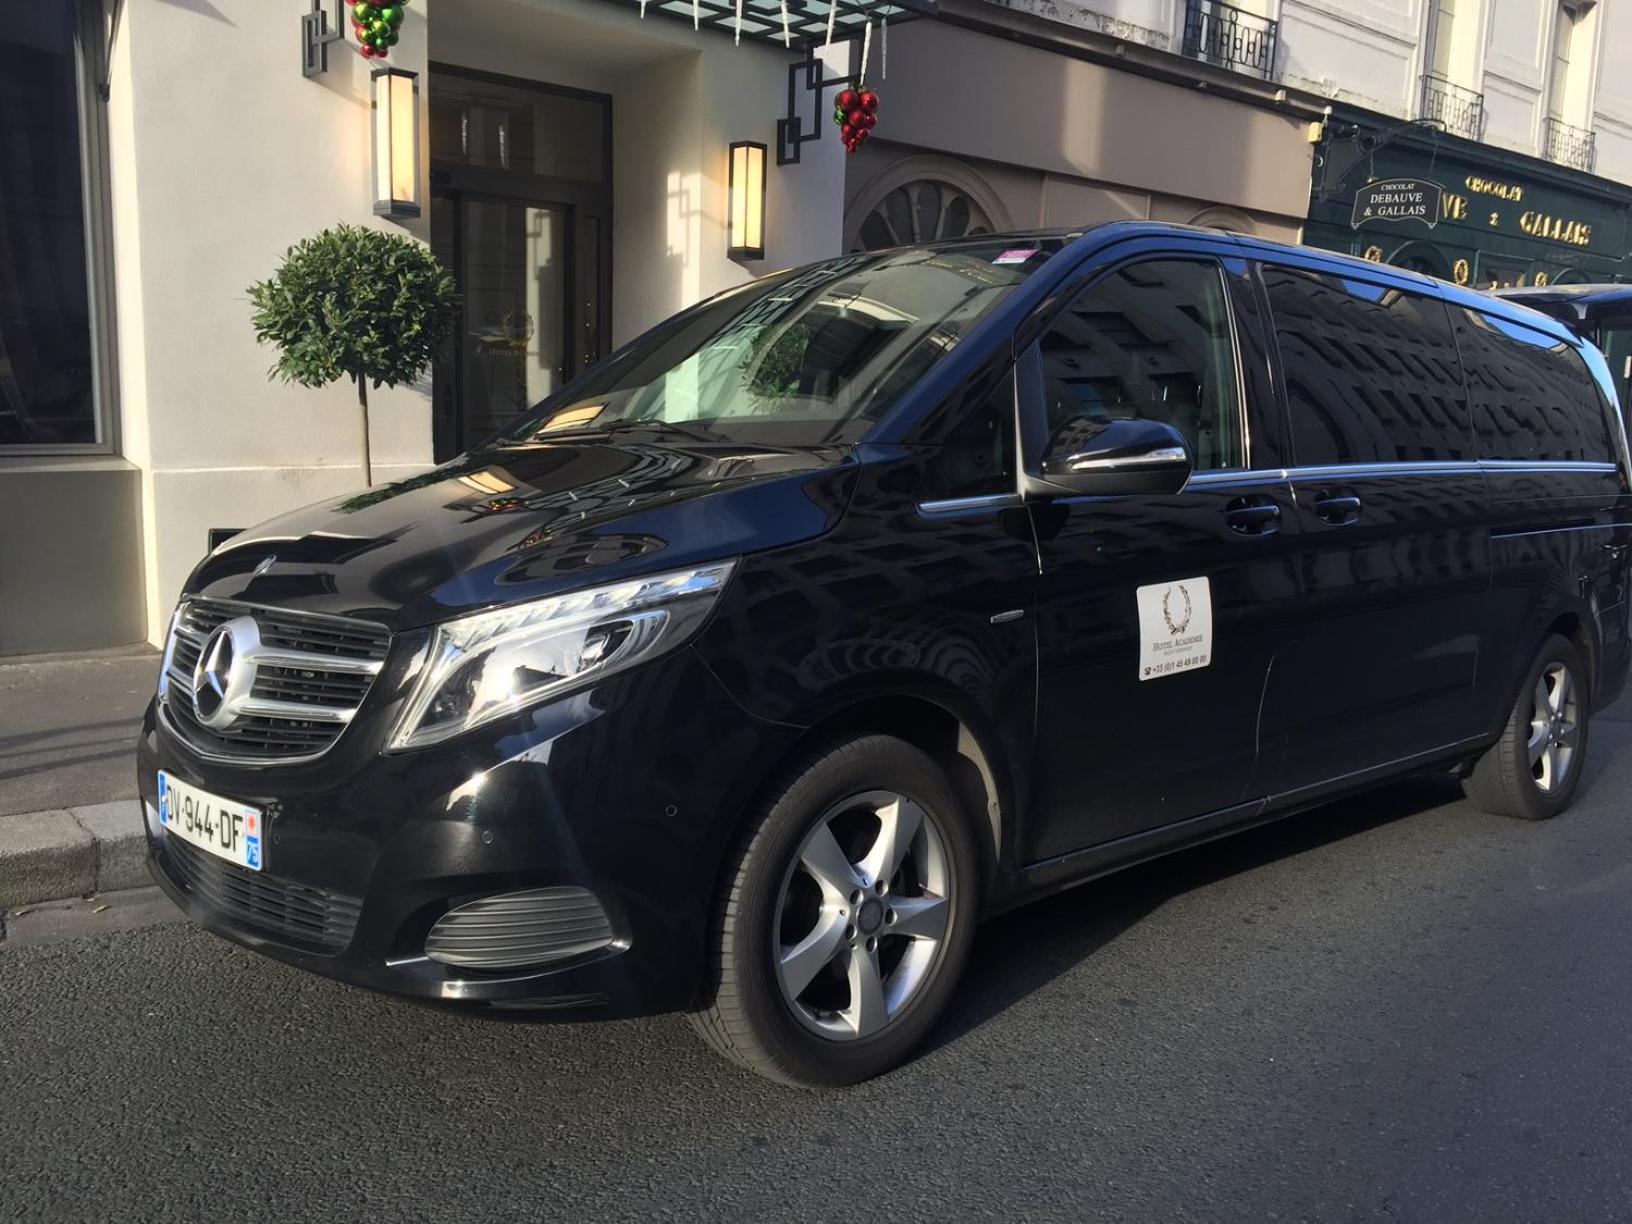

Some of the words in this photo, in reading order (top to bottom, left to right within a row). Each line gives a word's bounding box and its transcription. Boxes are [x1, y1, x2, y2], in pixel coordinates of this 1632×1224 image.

[1381, 183, 1416, 191] CHOCOLAT
[1465, 175, 1523, 201] CHOCOLAT
[1370, 192, 1423, 204] DEBAUVE
[1363, 206, 1372, 216] &
[1377, 205, 1426, 216] GALLAIS
[1519, 210, 1592, 245] GALLAIS
